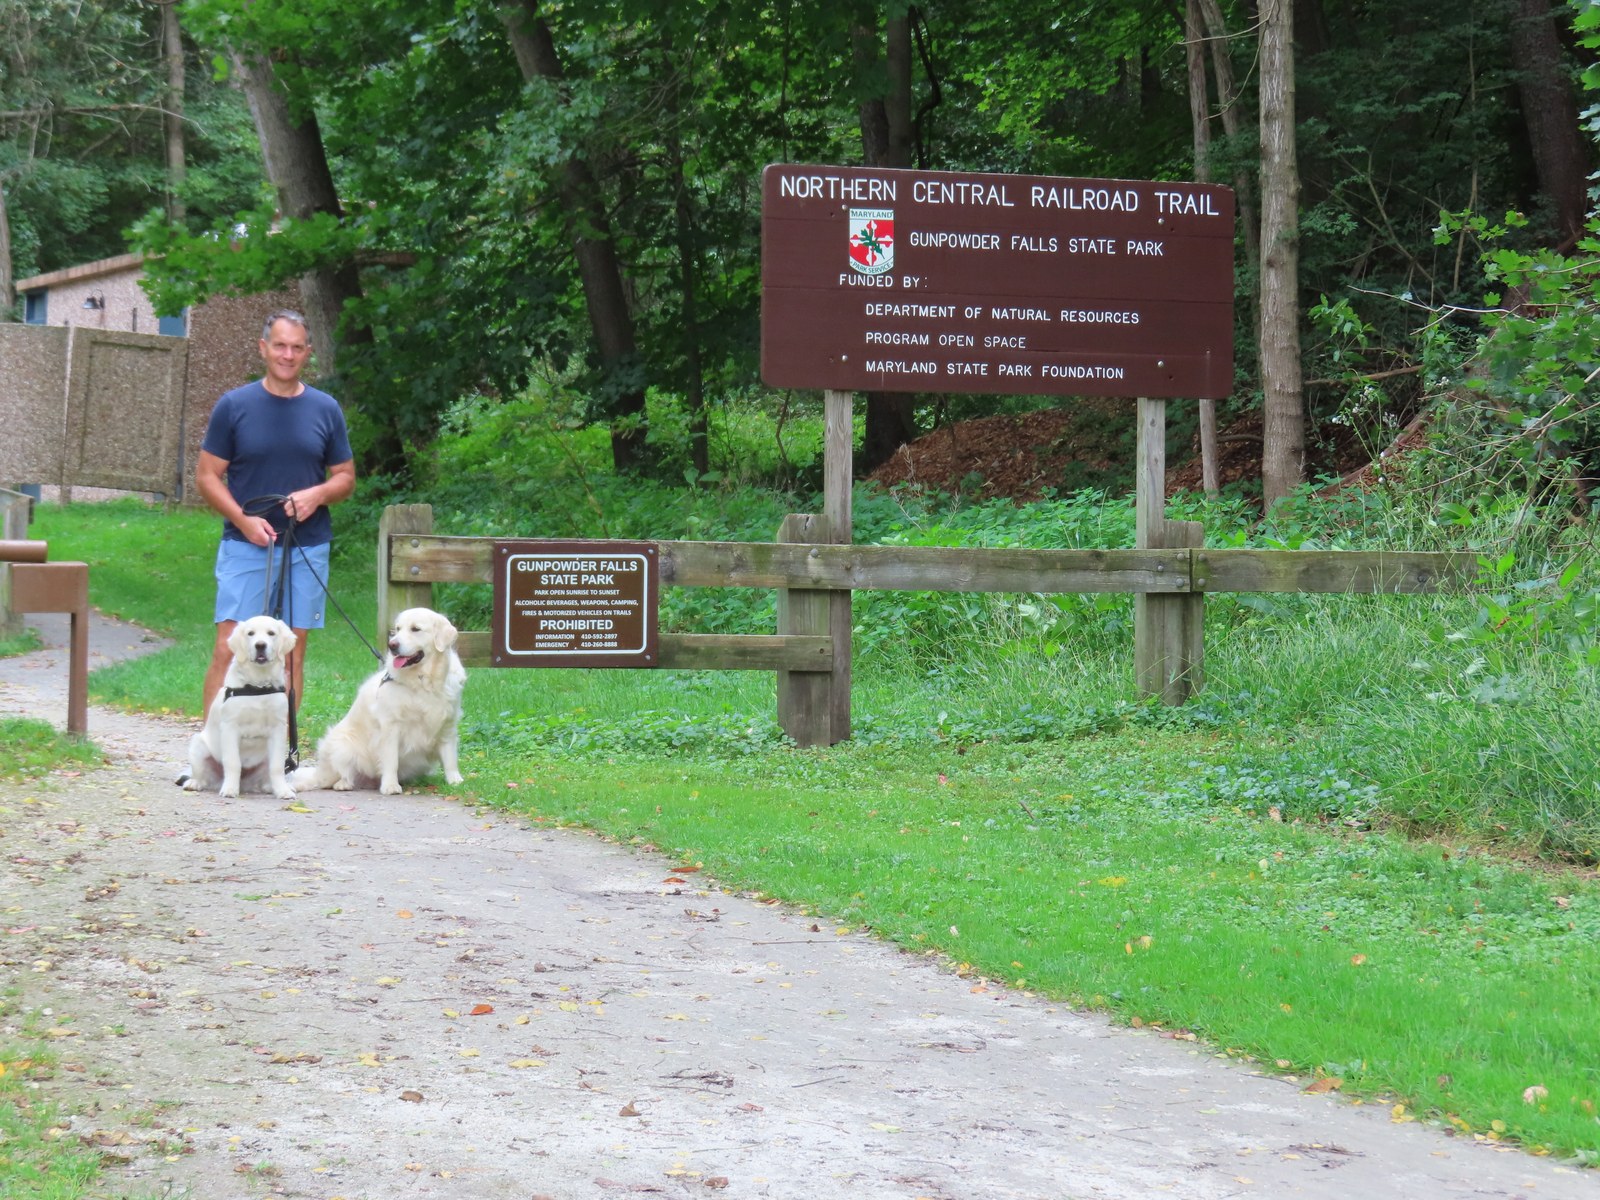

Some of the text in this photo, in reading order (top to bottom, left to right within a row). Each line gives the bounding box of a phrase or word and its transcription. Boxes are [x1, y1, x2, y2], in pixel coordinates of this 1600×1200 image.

[781, 175, 1220, 216] NORTHERN CENTRAL RAILROAD TRAIL
[851, 210, 893, 219] MARYLAND
[910, 232, 1164, 256] GUNPOWDER FALLS STATE PARK
[852, 262, 892, 274] PARK SERVICE
[839, 273, 894, 287] FUNDED
[865, 303, 1139, 324] DEPARTMENT OF NATURAL RESOURCES
[865, 332, 1026, 349] PROGRAM OPEN SPACE
[865, 360, 1124, 380] MARYLAND STATE PARK FOUNDATION
[517, 560, 638, 572] GUNPOWDER FALLS
[540, 574, 614, 585] STATE PARK
[546, 599, 580, 607] BEVERAGES,
[580, 599, 610, 607] WEAPONS,
[610, 599, 639, 607] CAMPING,
[540, 619, 614, 631] PROHIBITED
